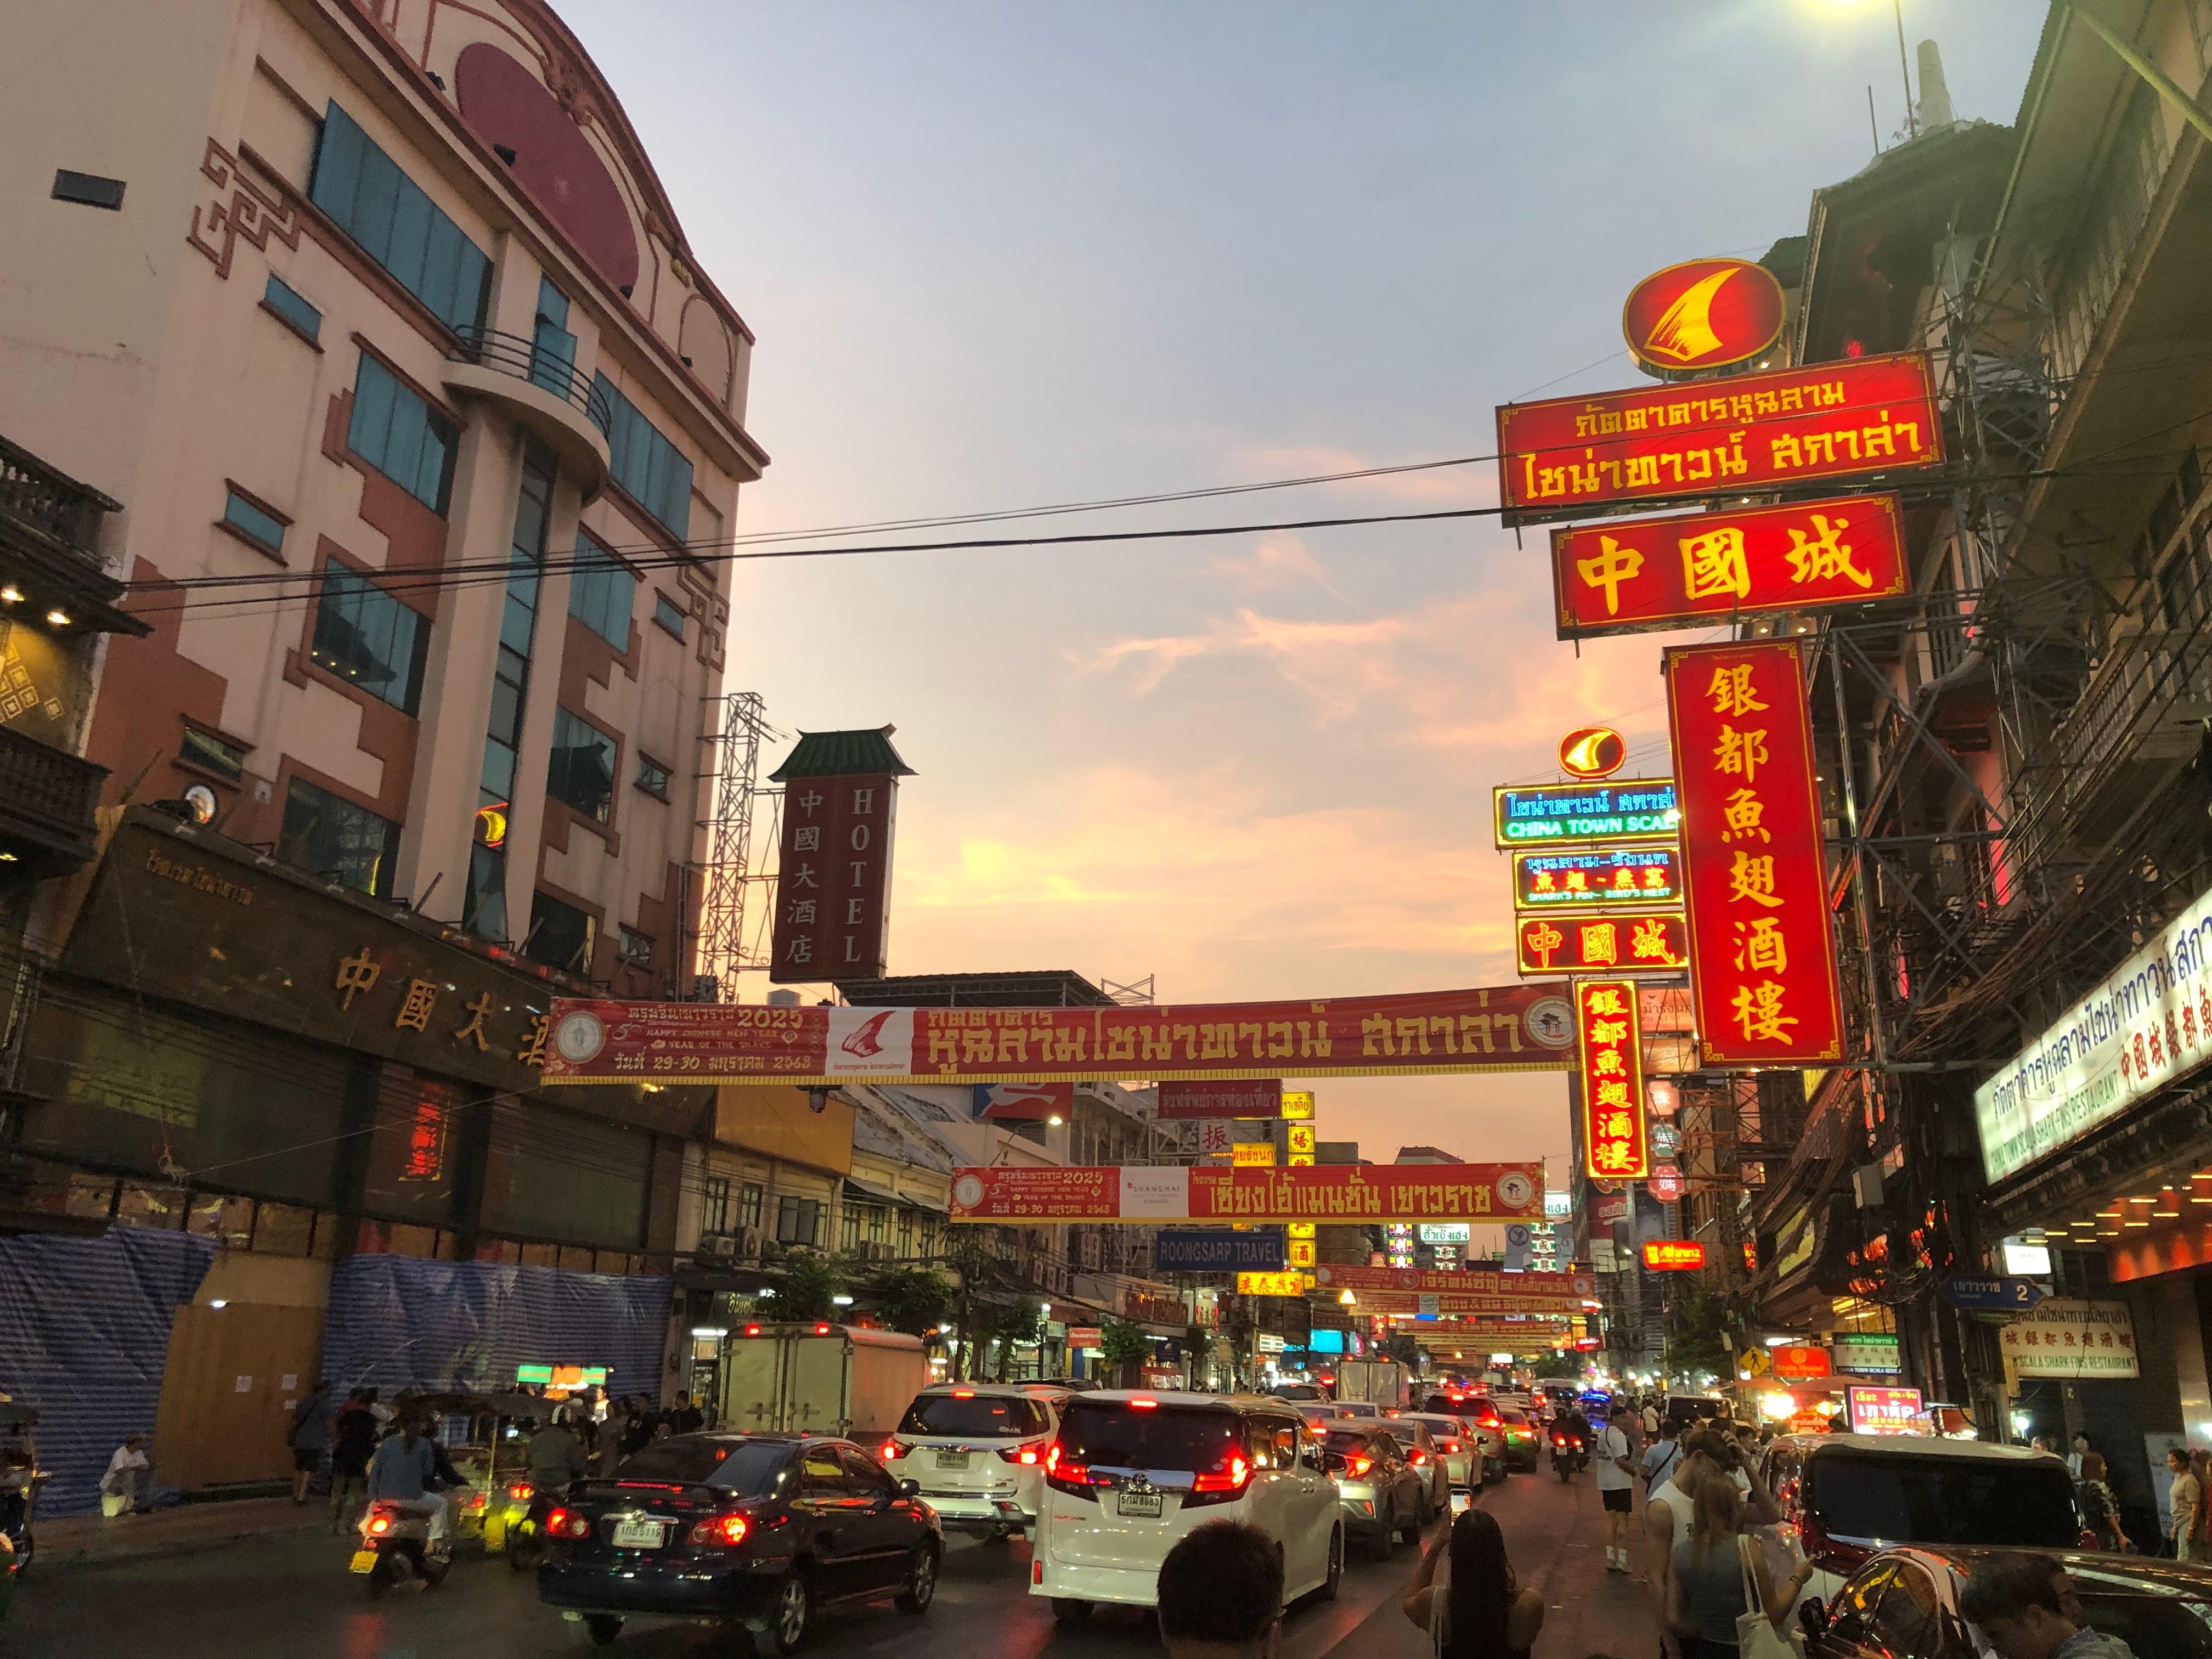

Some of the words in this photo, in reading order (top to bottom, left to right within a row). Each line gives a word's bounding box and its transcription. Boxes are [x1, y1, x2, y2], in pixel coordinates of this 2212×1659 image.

[1517, 431, 1748, 500] ไชน่าทาวน์
[1772, 411, 1922, 470] สกาล่า
[1577, 514, 1872, 616] 中國城
[1507, 791, 1609, 817] ไชน่าทาวน์
[1618, 786, 1675, 812] สกาล่
[1507, 820, 1563, 838] CHINA
[1567, 817, 1622, 835] TOWN
[1627, 815, 1678, 832] SCAL
[1705, 664, 1799, 1045] 銀都魚翅酒樓
[784, 789, 825, 964] 中國大酒店
[843, 788, 875, 963] HOTEL
[1528, 891, 1572, 901] SHARK'S
[1606, 889, 1641, 898] BIRD'S
[1644, 888, 1671, 896] NEST
[1527, 919, 1675, 968] 中國城
[682, 1029, 722, 1037] CHINESE
[754, 1029, 778, 1037] YEAR
[737, 1008, 804, 1029] 2025
[1361, 990, 1526, 1058] สกาล่า
[614, 1046, 646, 1070] วันที่
[653, 1056, 701, 1070] 29-30
[708, 1056, 765, 1073] มกราคม
[773, 1056, 812, 1070] 2568
[1586, 989, 1639, 1171] 銀都魚翅酒樓
[2069, 1070, 2120, 1122] RESTAURANT
[1063, 1171, 1104, 1185] 2025
[991, 1199, 1010, 1214] วันที่
[1014, 1205, 1043, 1214] 29-30
[1086, 1205, 1110, 1214] 2568
[1389, 1183, 1492, 1214] เยาวราช
[1160, 1242, 1231, 1262] ROONGSARP
[1235, 1242, 1279, 1262] TRAVEL
[1953, 1280, 2001, 1293] เยาวราช
[2016, 1284, 2029, 1301] 2
[2019, 1355, 2044, 1368] SCALA
[2045, 1356, 2087, 1369] SHARK-FINS
[2089, 1356, 2136, 1370] RESTAURANT
